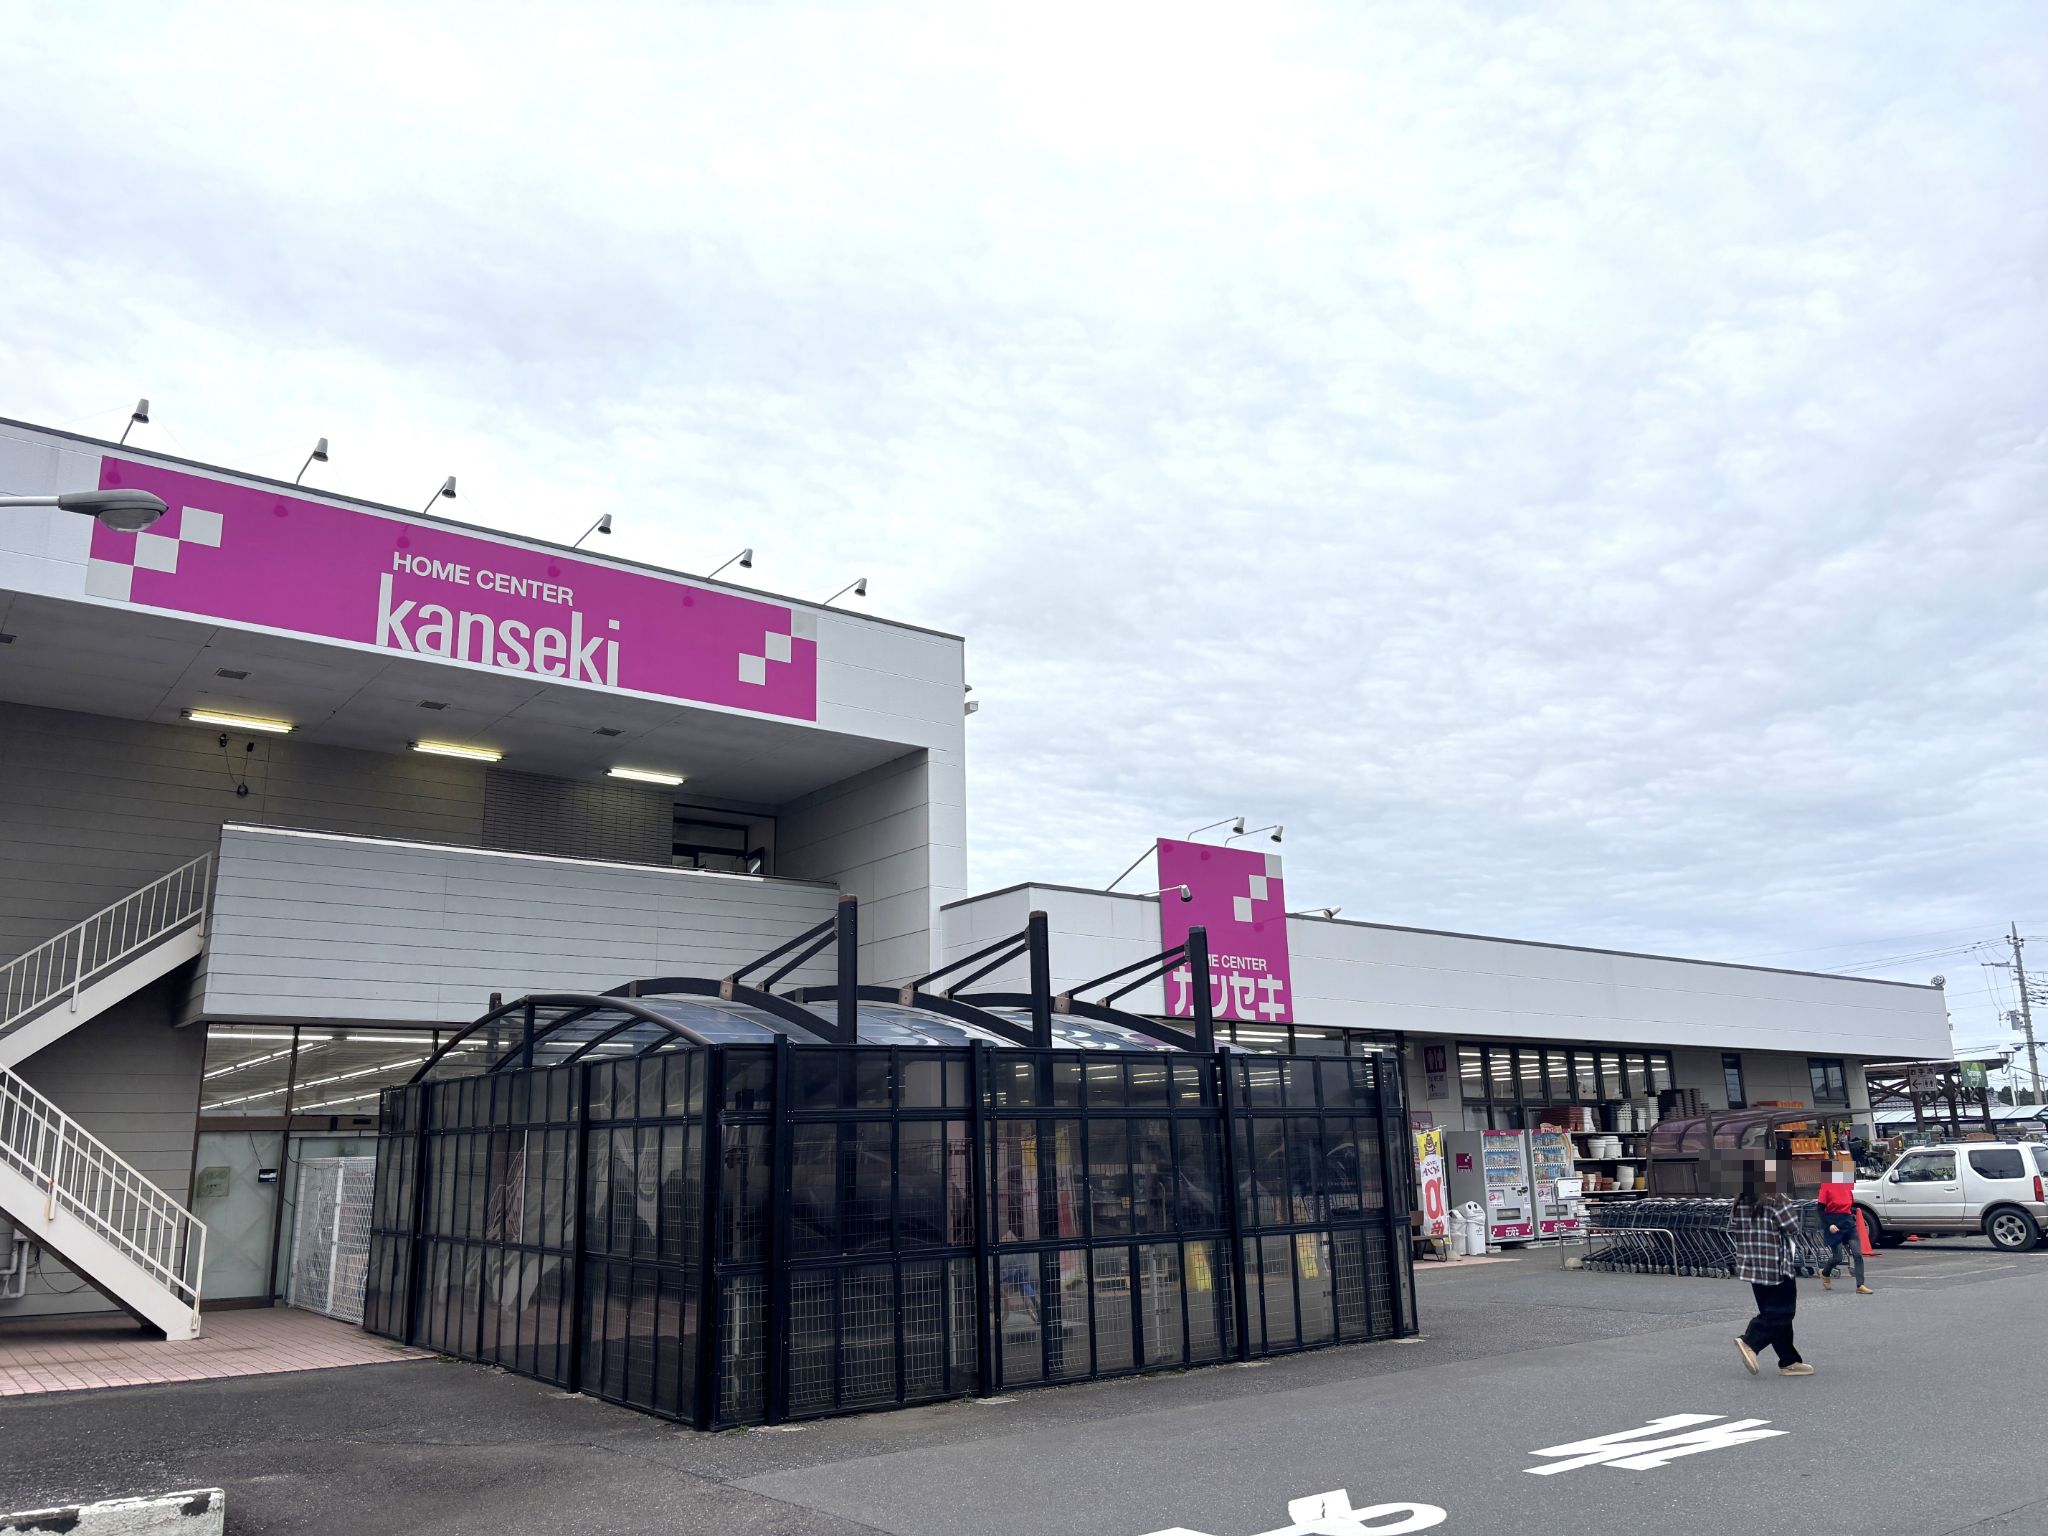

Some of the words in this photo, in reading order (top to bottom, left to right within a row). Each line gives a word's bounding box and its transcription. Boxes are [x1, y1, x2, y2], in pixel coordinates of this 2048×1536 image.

[393, 551, 471, 585] HOME
[476, 569, 574, 606] CENTER
[375, 572, 620, 687] kanseki
[1221, 954, 1267, 971] CENTER
